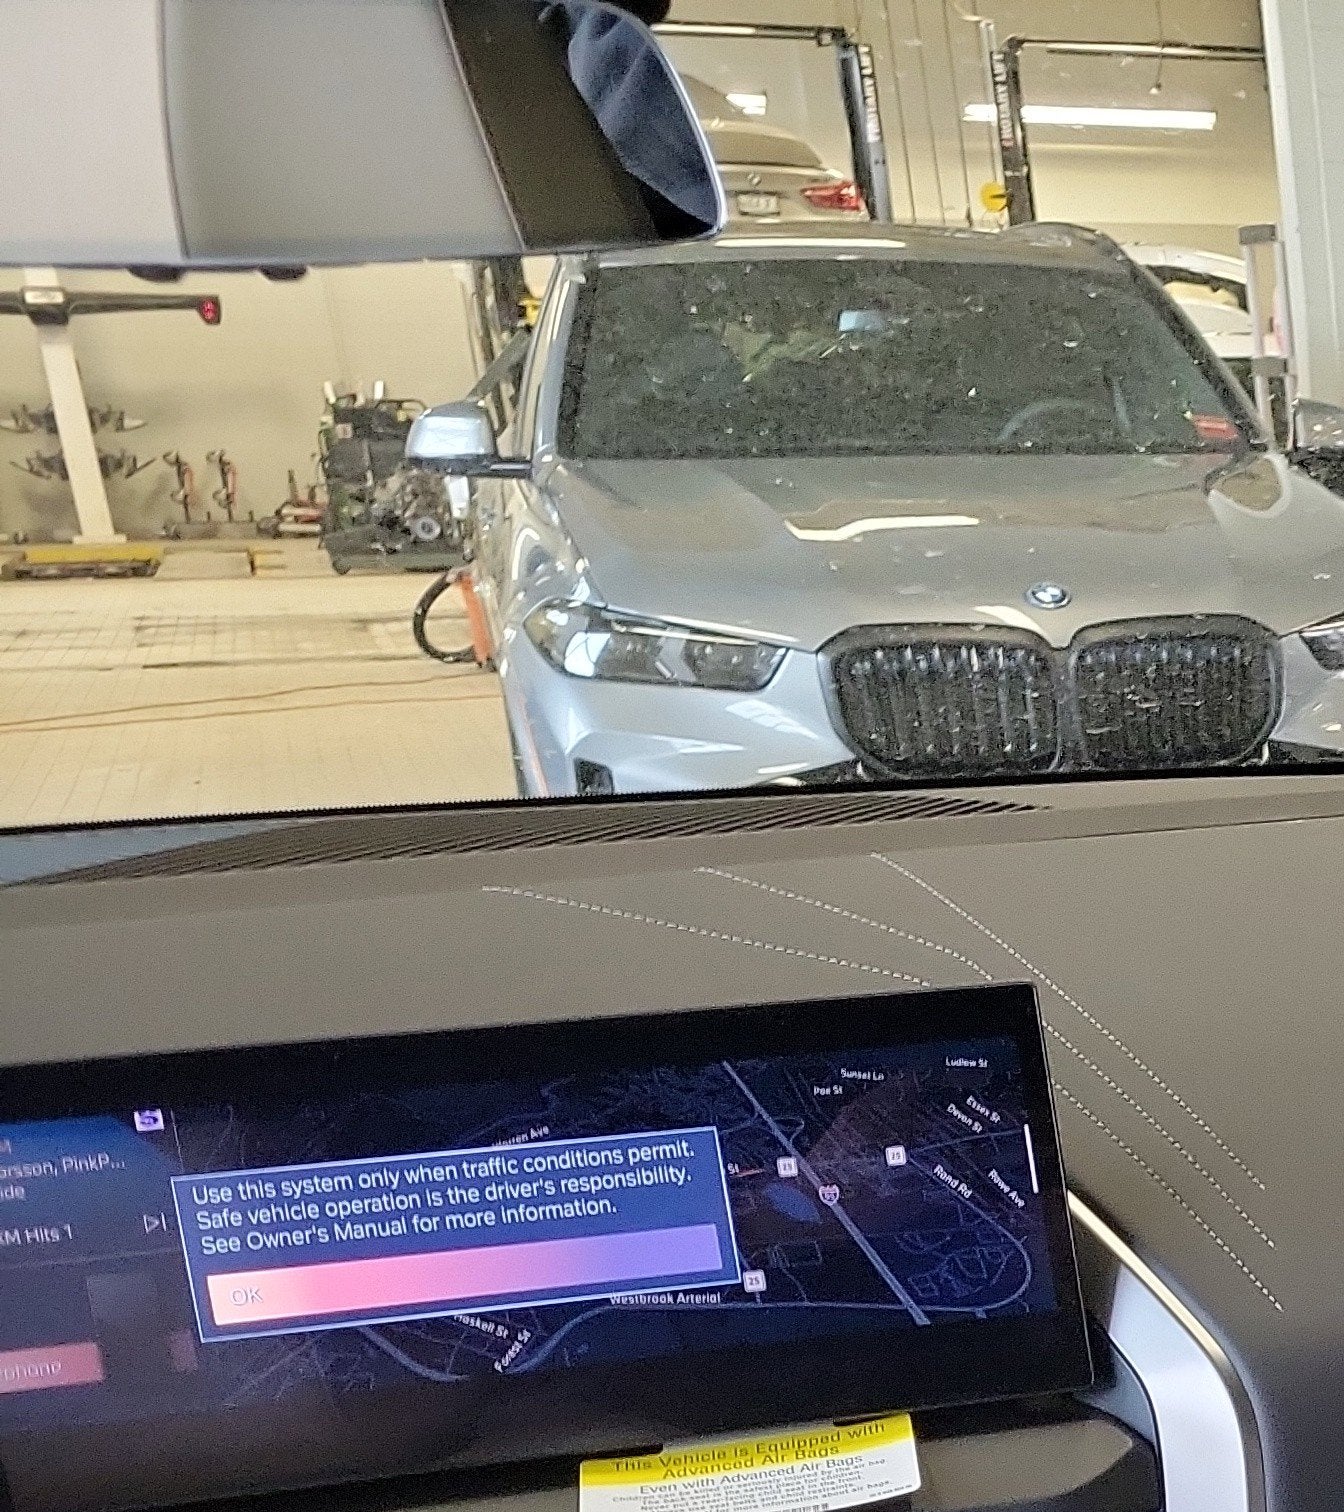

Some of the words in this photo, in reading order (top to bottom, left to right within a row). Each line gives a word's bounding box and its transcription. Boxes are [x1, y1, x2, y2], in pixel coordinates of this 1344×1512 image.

[193, 1185, 232, 1205] Use
[238, 1180, 277, 1201] this
[281, 1175, 354, 1198] system
[358, 1166, 399, 1190] only
[404, 1163, 458, 1185] when
[461, 1154, 519, 1179] traffic
[523, 1146, 623, 1173] conditions
[628, 1139, 695, 1166] permit.
[196, 1209, 243, 1230] Safe
[248, 1202, 320, 1225] vehicle
[325, 1192, 422, 1220] operation
[427, 1187, 443, 1207] is
[448, 1182, 480, 1205] the
[485, 1178, 556, 1200] driver's
[560, 1164, 692, 1194] responsibility.
[202, 1236, 241, 1255] See
[247, 1226, 330, 1250] Owner's
[333, 1215, 407, 1242] Manual
[411, 1213, 441, 1233] for
[446, 1209, 496, 1230] more
[500, 1198, 617, 1225] information.
[230, 1286, 264, 1307] OK
[610, 1292, 674, 1305] Westbrook
[677, 1291, 721, 1305] Arterial
[613, 1460, 652, 1472] This
[659, 1450, 727, 1468] Vehicle
[756, 1431, 841, 1454] Equipped
[847, 1422, 886, 1438] with
[663, 1458, 755, 1479] Advanced
[762, 1452, 788, 1465] Air
[795, 1445, 840, 1461] Bags
[640, 1485, 677, 1494] Even
[682, 1478, 715, 1489] with
[720, 1465, 795, 1484] Advanced
[801, 1462, 821, 1473] Air
[826, 1455, 863, 1469] Bags
